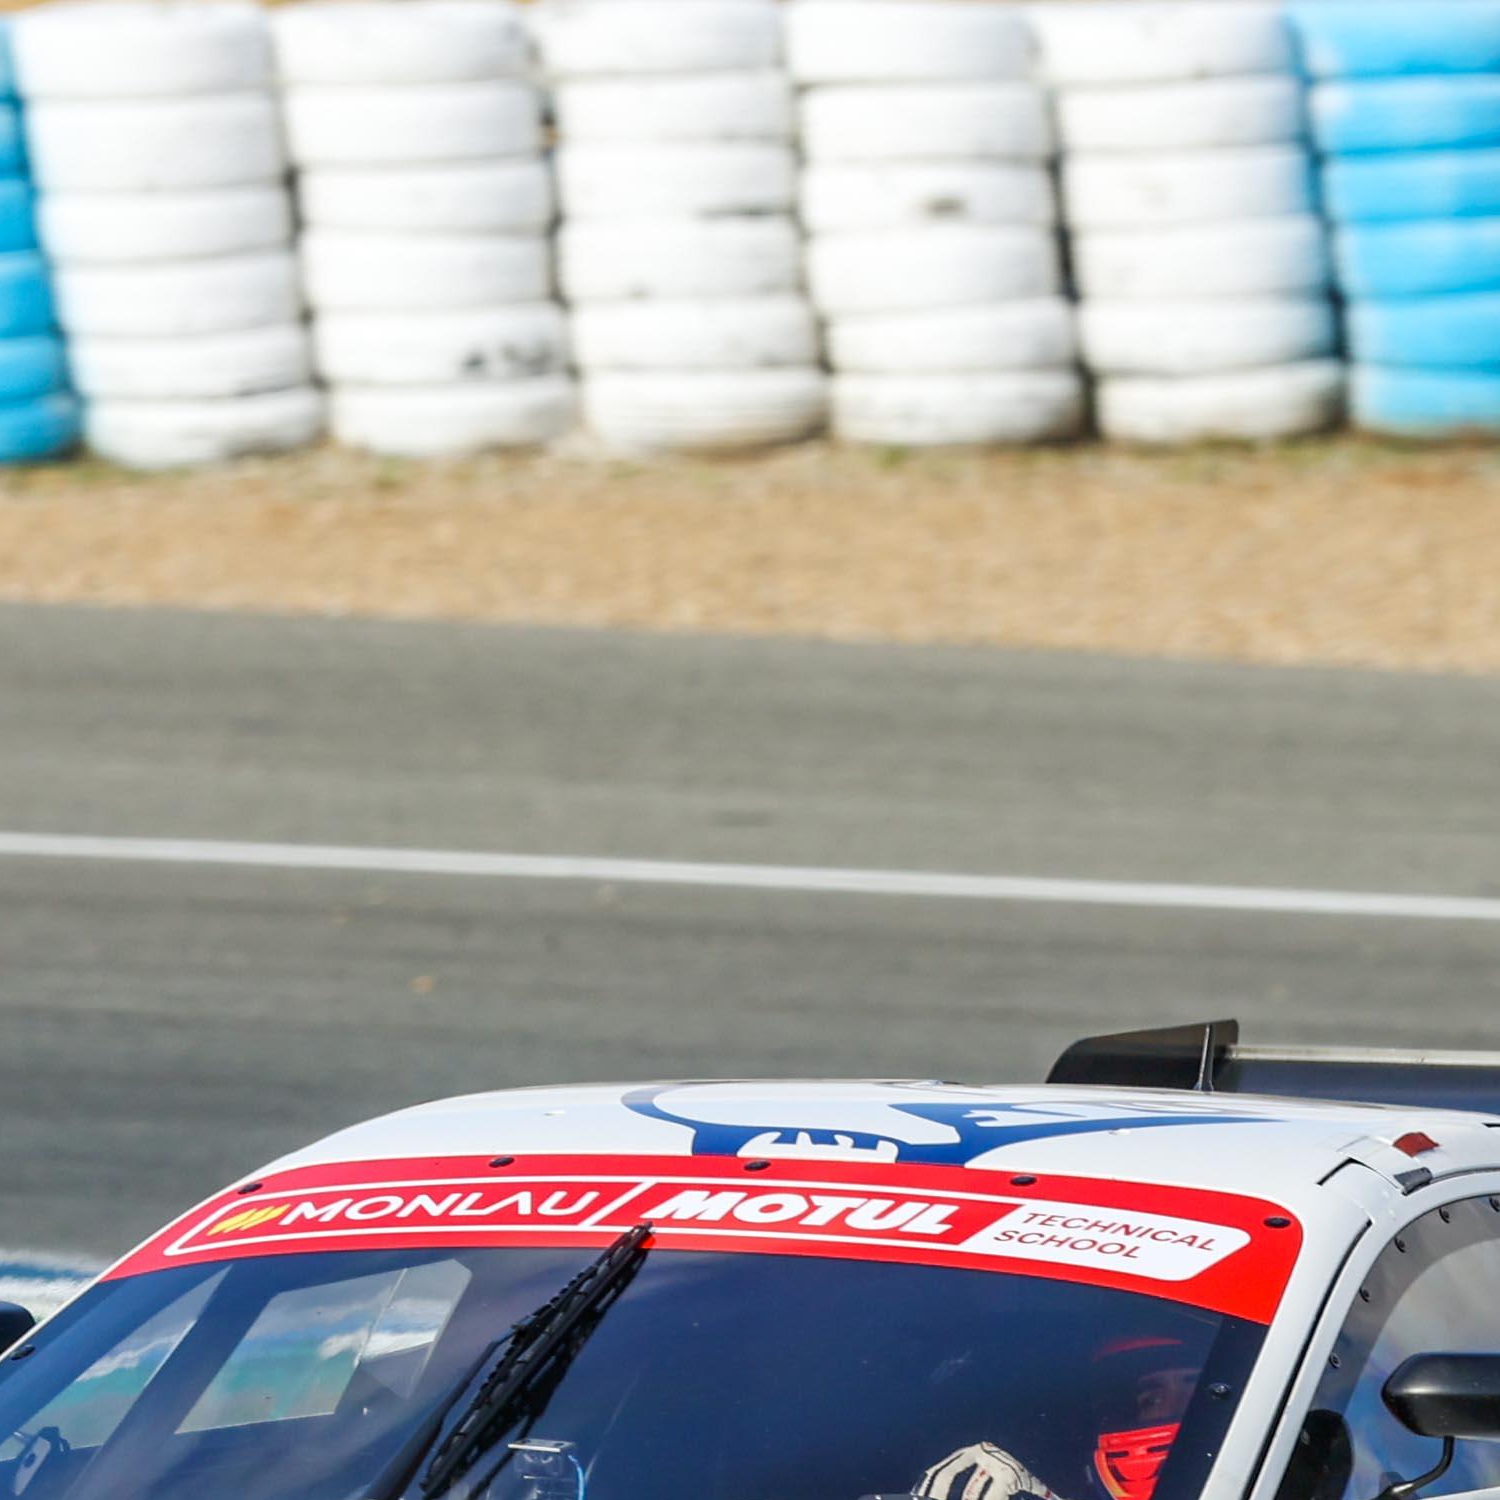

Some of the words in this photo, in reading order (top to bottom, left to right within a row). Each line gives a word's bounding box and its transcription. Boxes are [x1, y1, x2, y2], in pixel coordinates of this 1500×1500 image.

[278, 1190, 599, 1226] MONLAU
[640, 1190, 960, 1236] MOTUL
[993, 1229, 1141, 1260] SCHOOL
[1021, 1212, 1221, 1252] TECHNICAL
